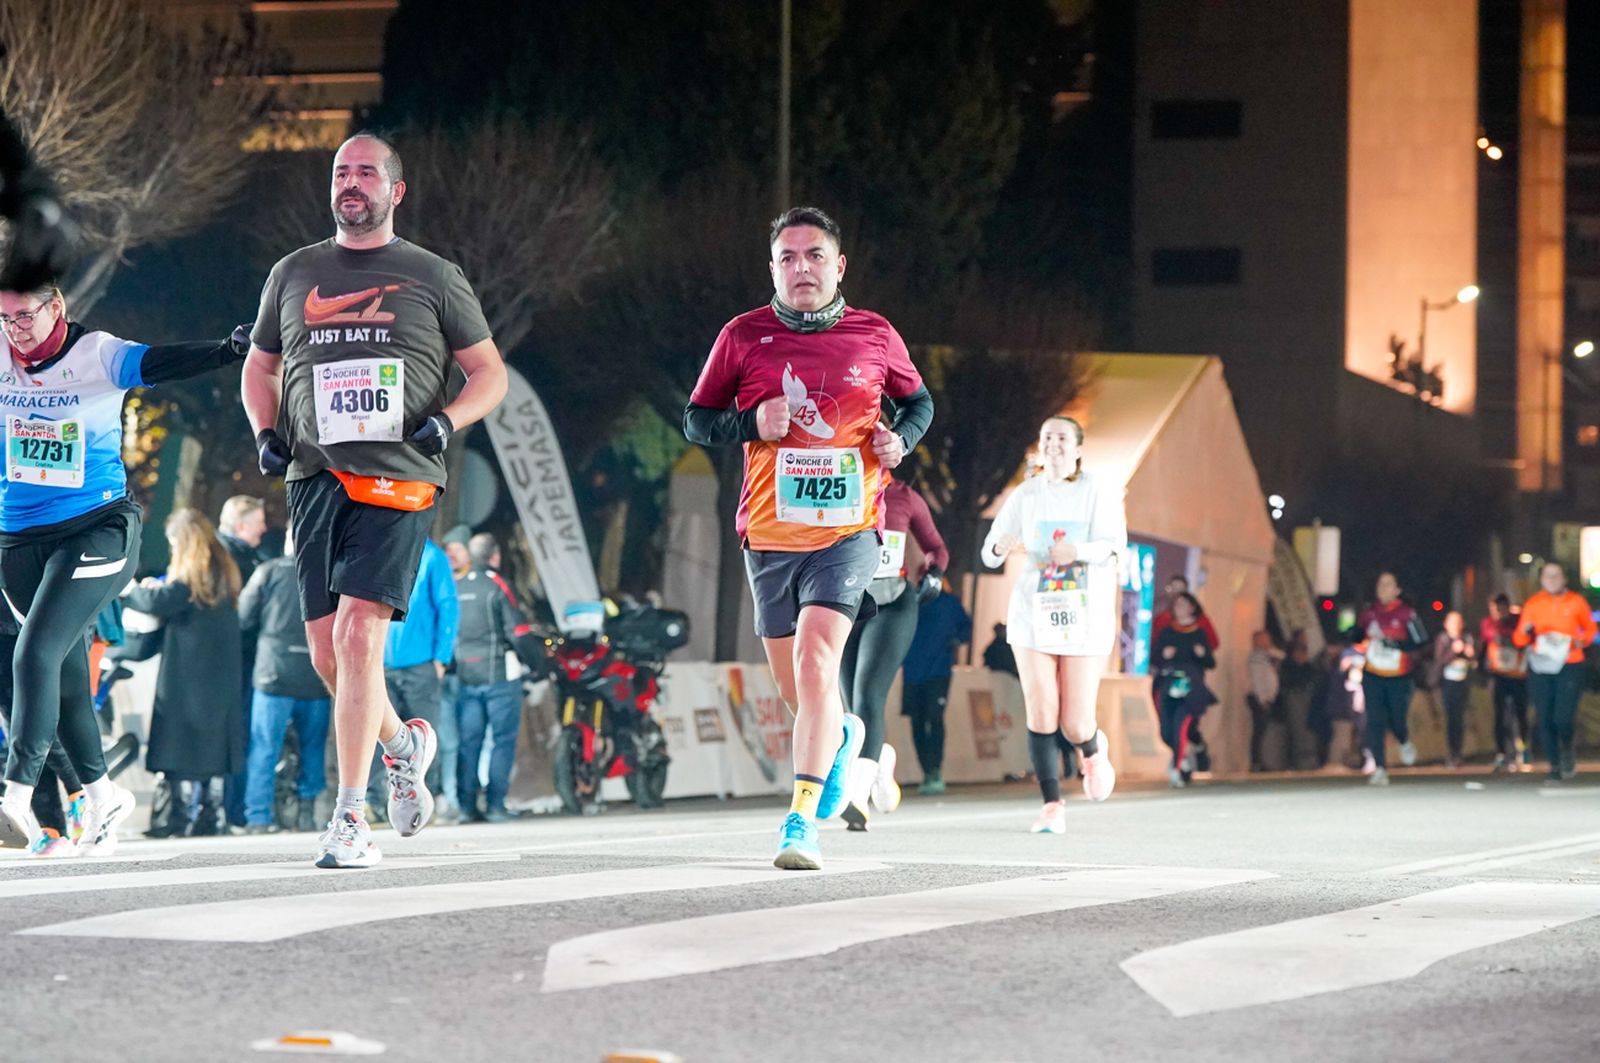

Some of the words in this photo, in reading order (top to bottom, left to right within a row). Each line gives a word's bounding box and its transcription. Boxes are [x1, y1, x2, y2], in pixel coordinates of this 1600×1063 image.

[309, 329, 341, 345] JUST
[345, 328, 371, 342] EAT
[375, 328, 391, 342] IT.
[333, 369, 359, 378] NOCHE
[360, 368, 371, 376] DE
[323, 381, 341, 391] SAN
[342, 377, 372, 388] ANTÓN
[0, 394, 80, 408] MARACENA
[330, 388, 389, 414] 4306
[794, 405, 817, 426] 43
[15, 429, 31, 438] SAN
[23, 424, 46, 432] NOCHE
[20, 438, 73, 463] 12731
[795, 458, 822, 466] NOCHE
[517, 399, 582, 553] JAPEMASA
[785, 466, 803, 475] SAN
[804, 465, 833, 476] ANTÓN
[793, 477, 847, 500] 7425
[1050, 611, 1077, 626] 988
